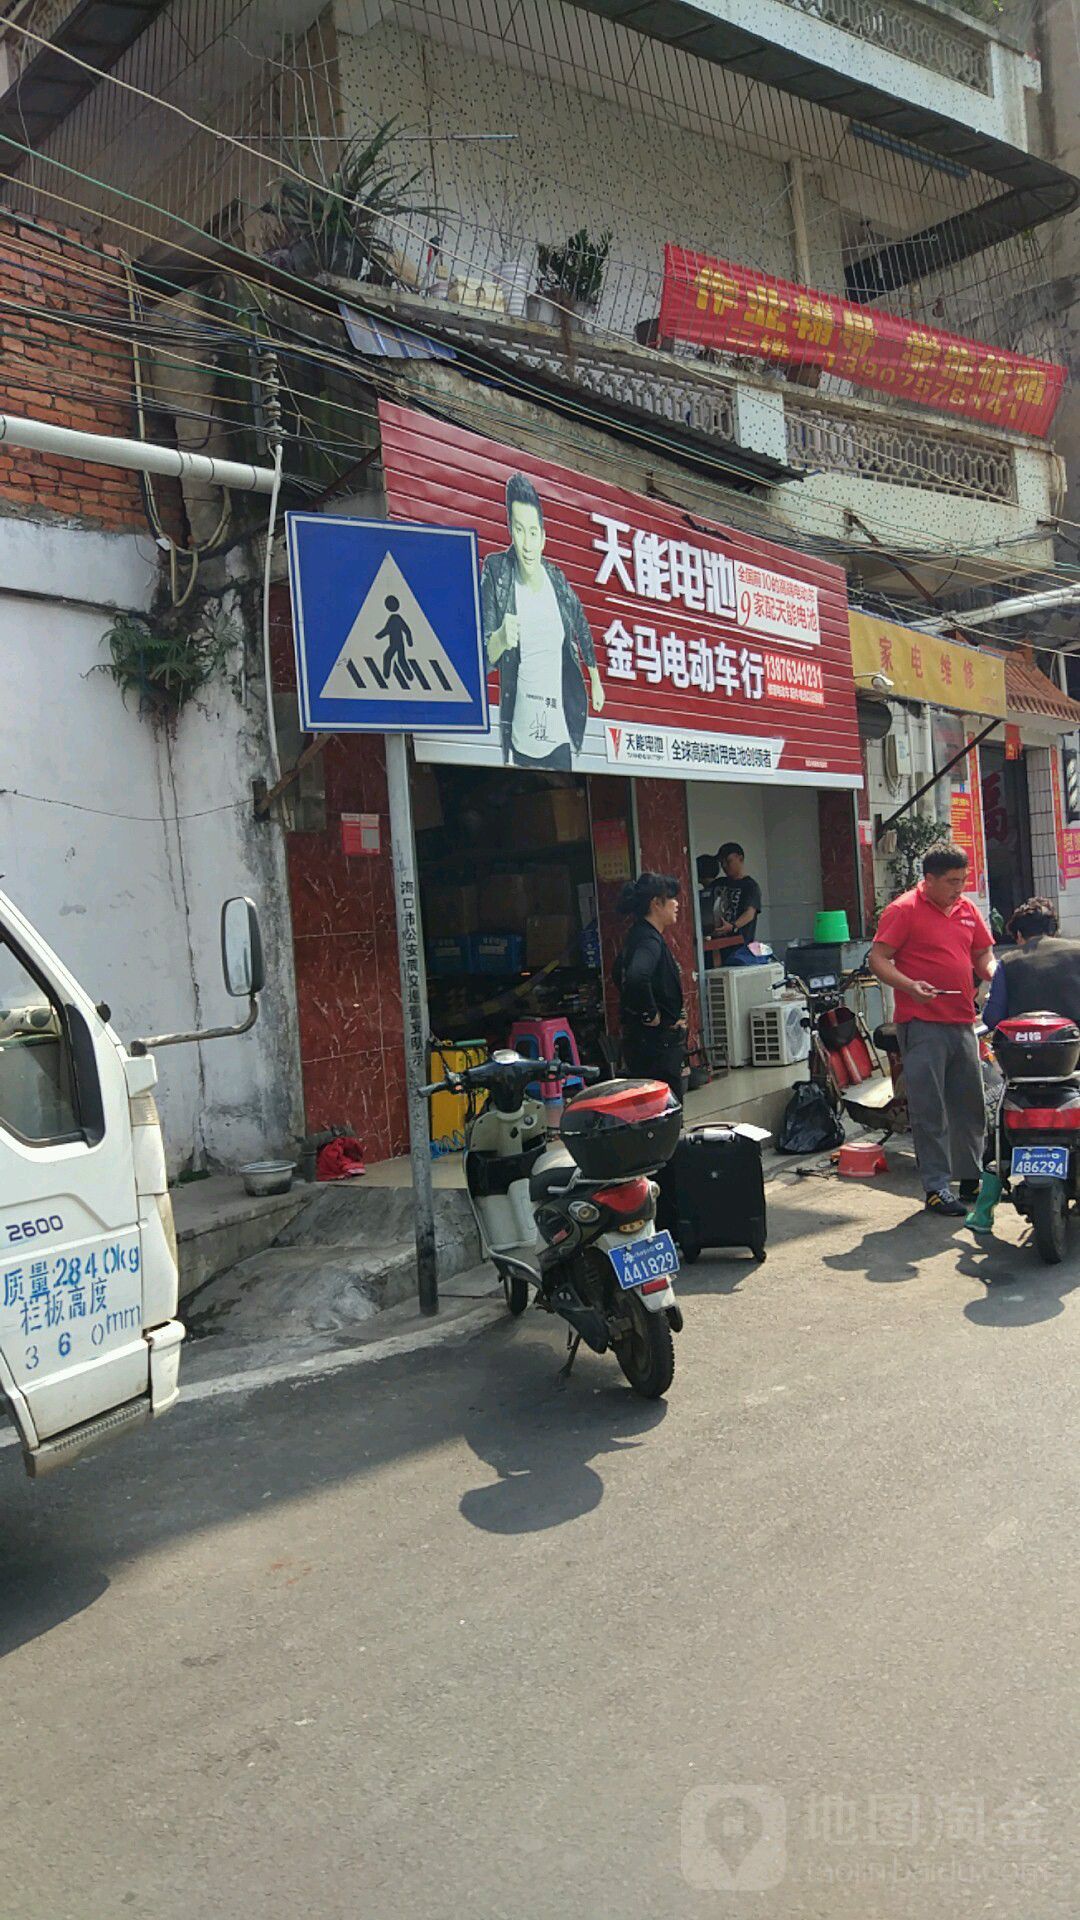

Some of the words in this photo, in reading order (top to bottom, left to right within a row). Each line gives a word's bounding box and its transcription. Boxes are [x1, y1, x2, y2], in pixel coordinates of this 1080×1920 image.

[590, 512, 737, 619] 天能电池
[603, 619, 764, 699] 金马电动车行
[879, 635, 975, 689] 家电维修
[625, 733, 664, 753] 天能电池
[1015, 1161, 1063, 1175] 486294
[6, 1215, 64, 1242] 2600
[624, 1252, 673, 1283] 441829
[20, 1277, 108, 1336] 栏板高度
